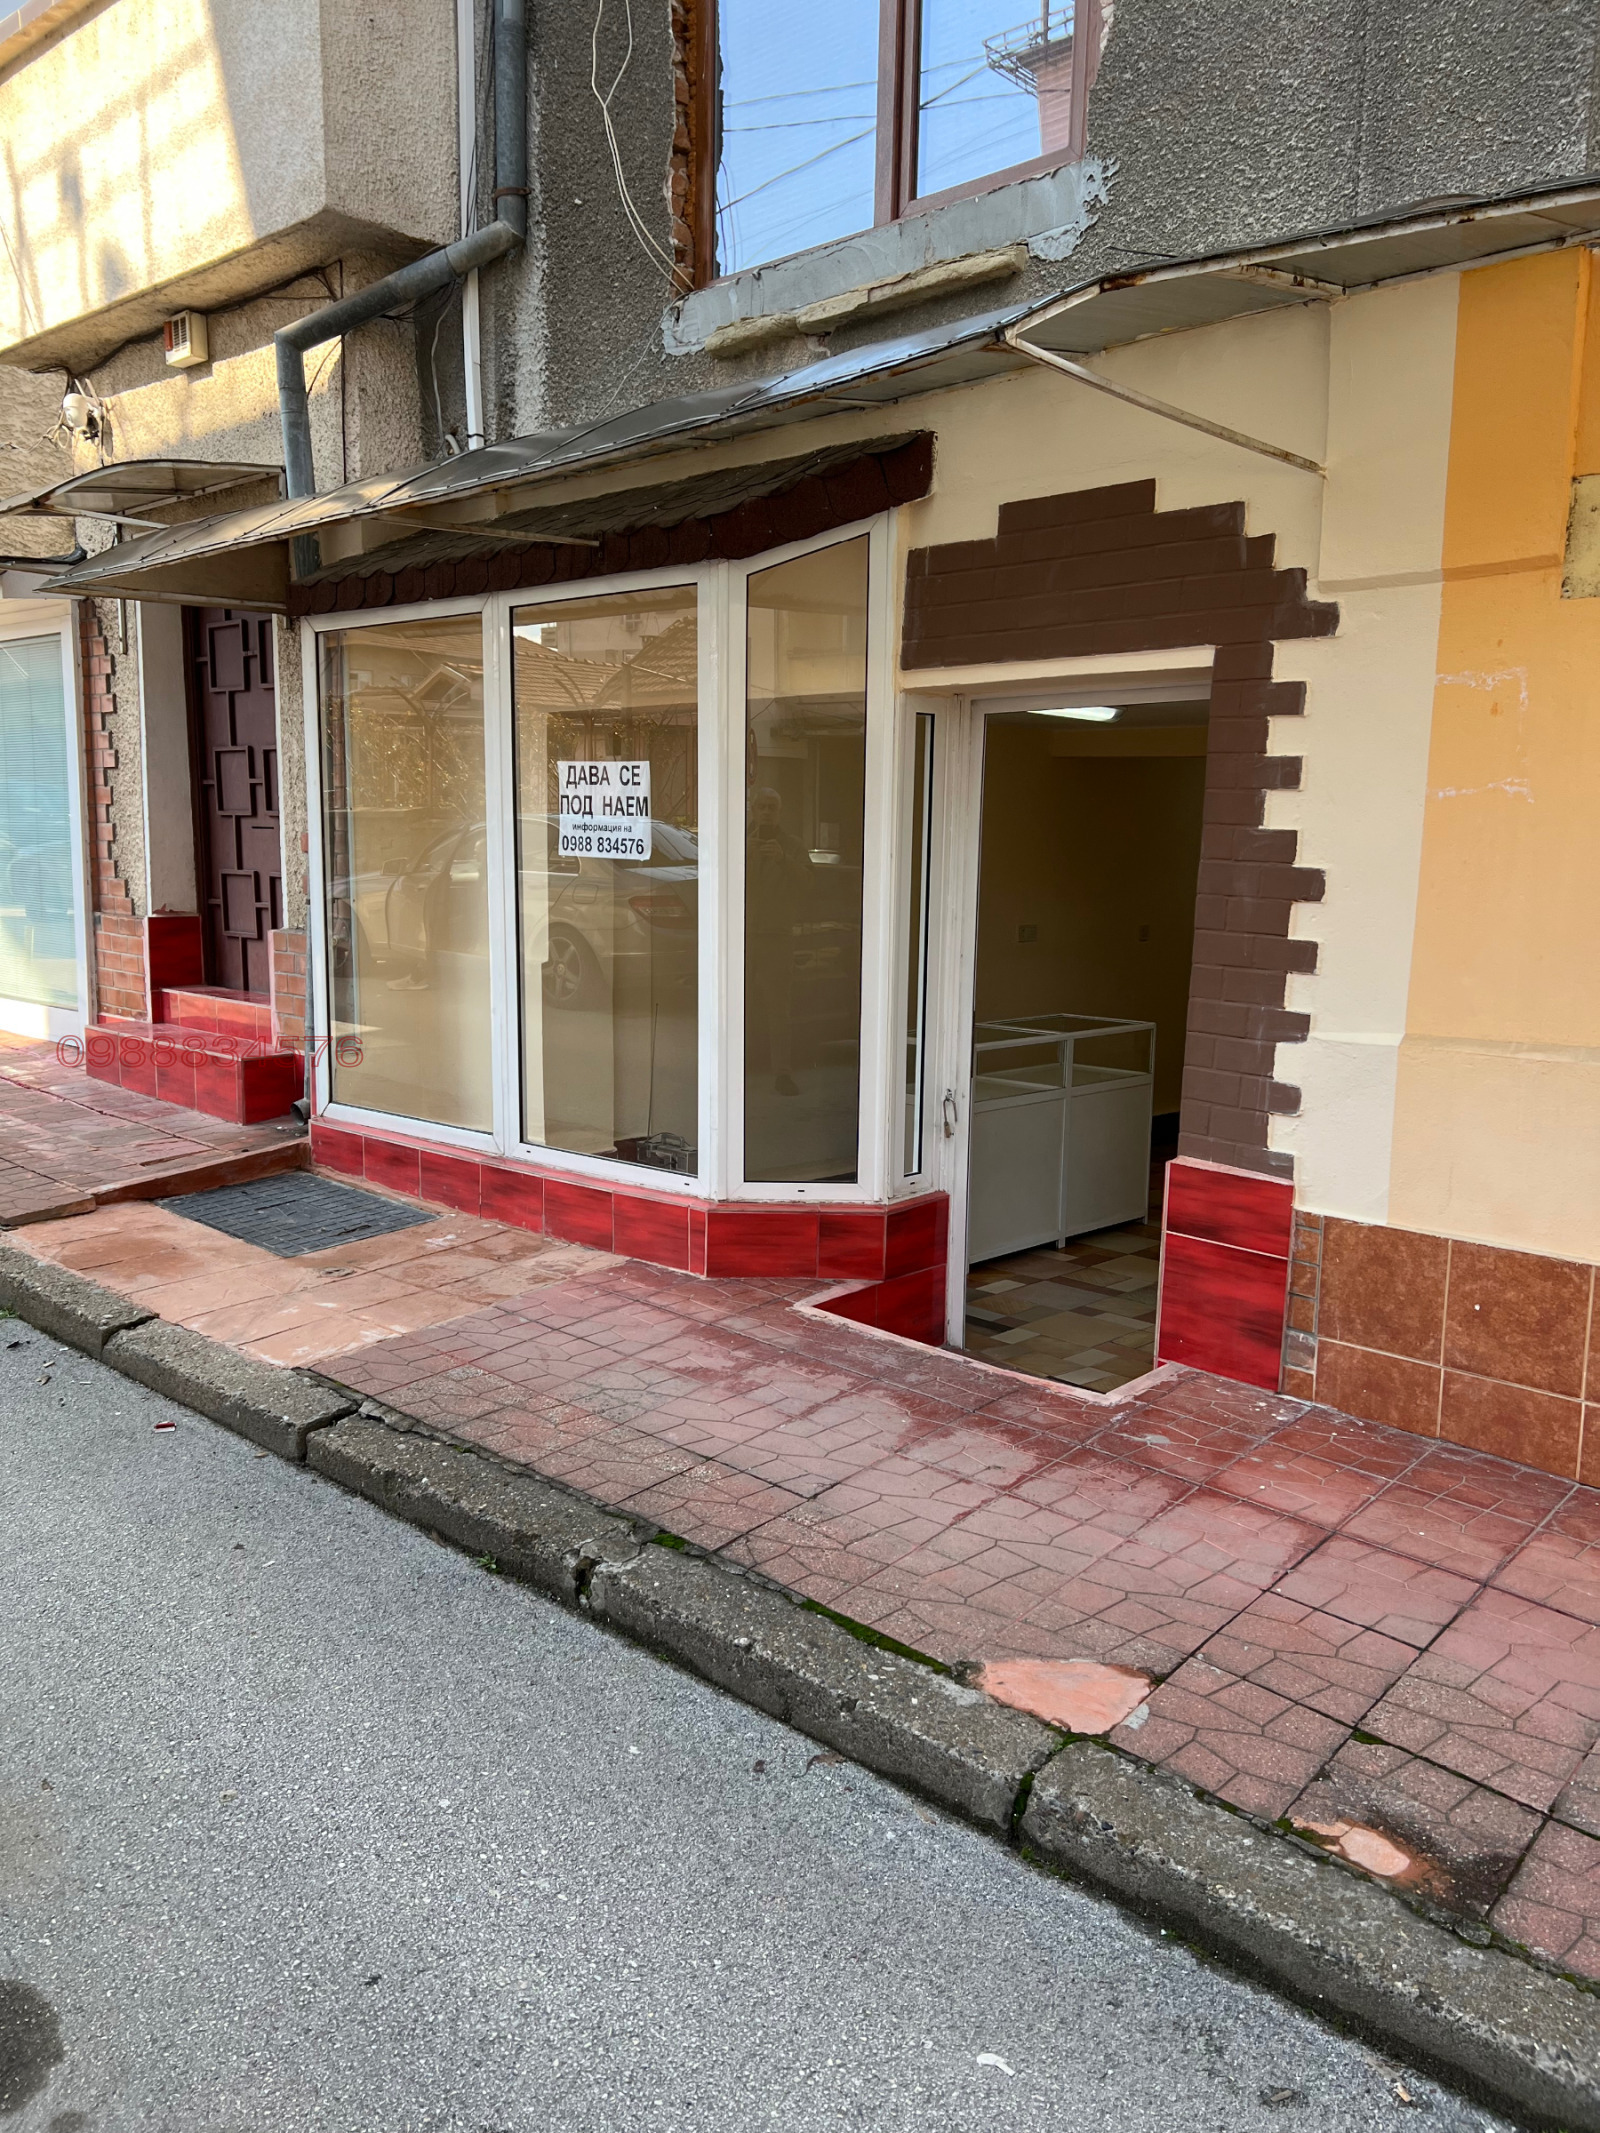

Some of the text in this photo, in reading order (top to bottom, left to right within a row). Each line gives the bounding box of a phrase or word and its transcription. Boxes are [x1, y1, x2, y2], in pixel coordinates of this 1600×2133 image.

[566, 765, 641, 789] ДАВА СЕ
[560, 795, 649, 819] ПОД НАЕМ
[572, 822, 622, 833] информация
[562, 835, 645, 855] 0988 834576
